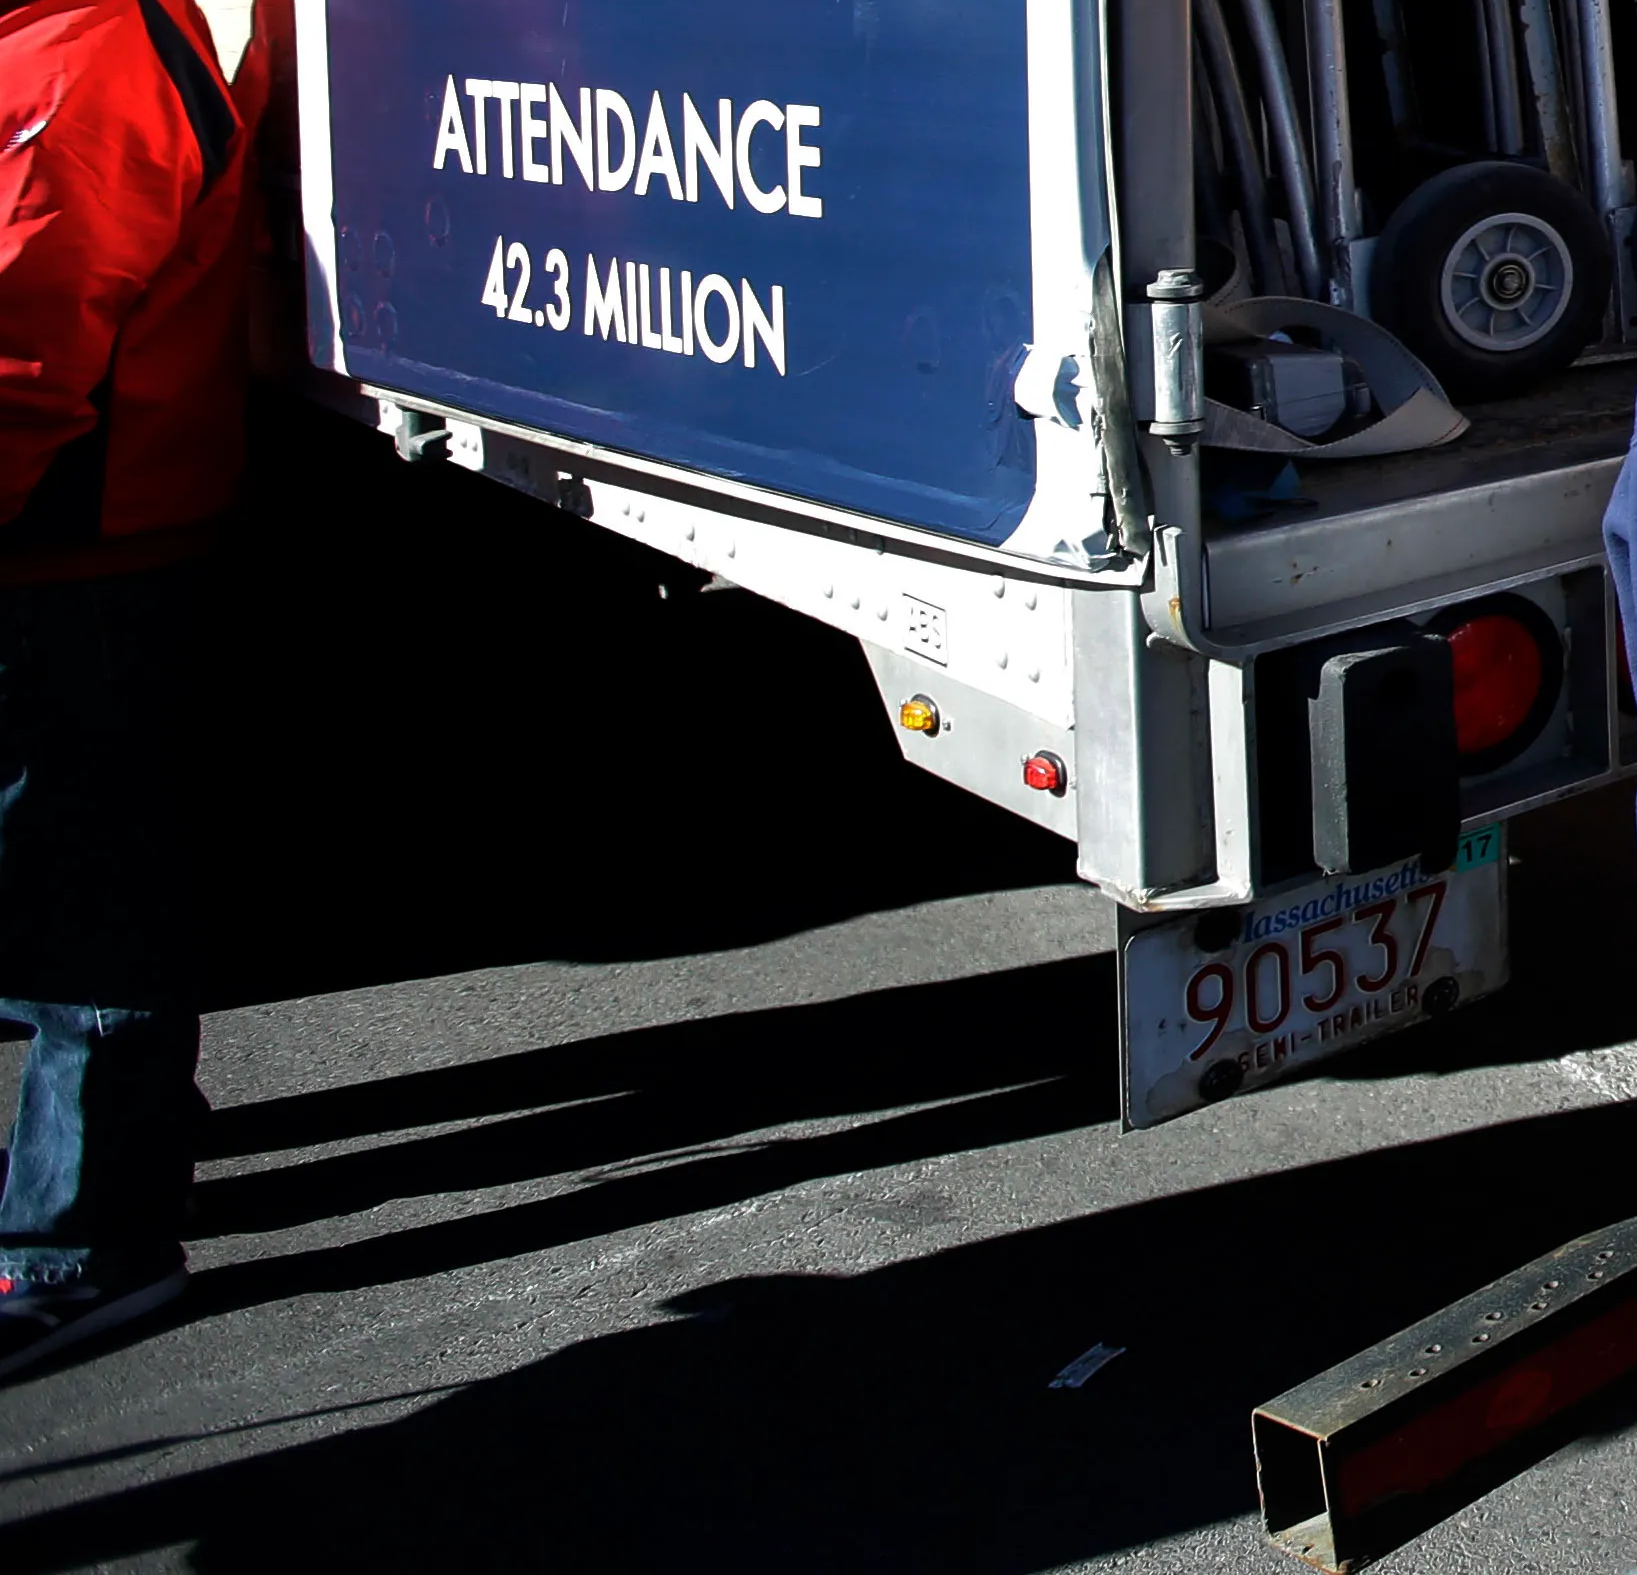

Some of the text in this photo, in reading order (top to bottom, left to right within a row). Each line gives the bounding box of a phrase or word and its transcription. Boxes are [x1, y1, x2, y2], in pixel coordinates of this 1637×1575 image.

[432, 74, 823, 218] ATTENDANCE
[481, 235, 786, 377] 42.3 MILLION
[1461, 834, 1492, 864] 17
[1186, 880, 1447, 1062] 90537
[1238, 985, 1419, 1073] SEMI-TRAILER
